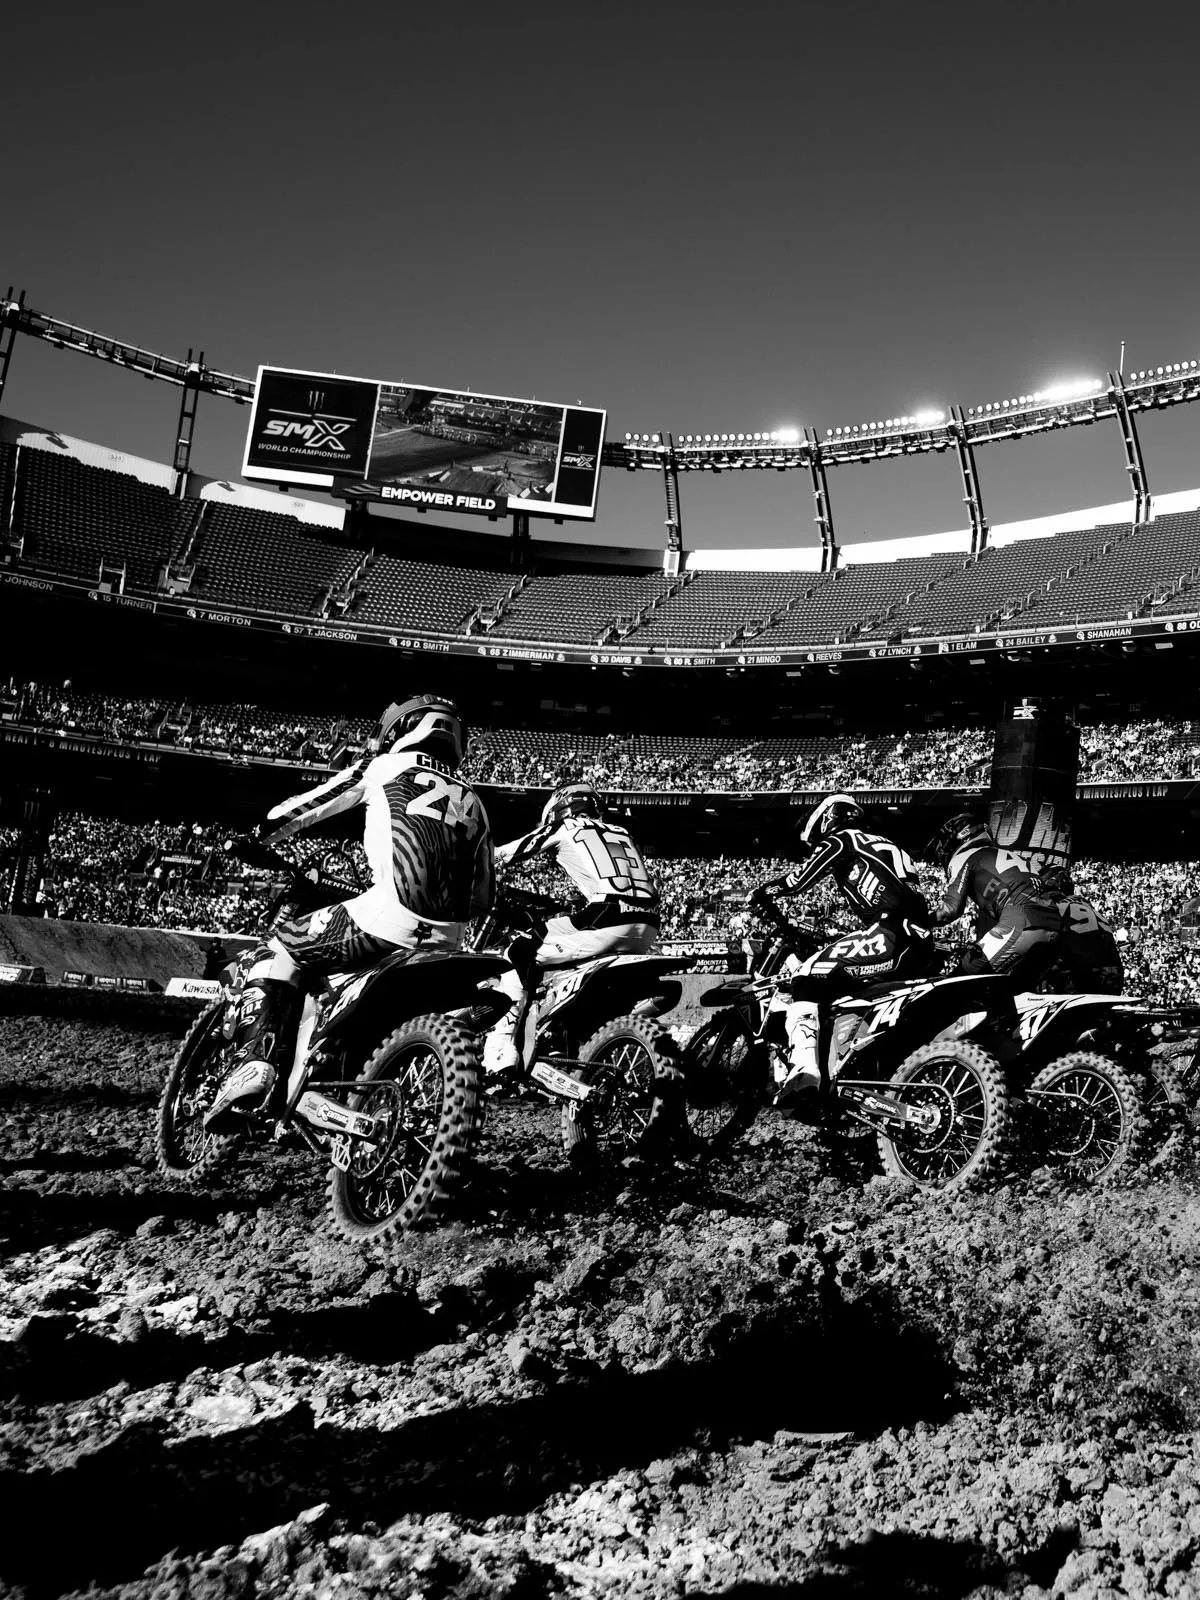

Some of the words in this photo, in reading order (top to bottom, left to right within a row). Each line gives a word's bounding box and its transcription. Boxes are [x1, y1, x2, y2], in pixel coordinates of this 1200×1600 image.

[262, 418, 351, 451] SMX
[257, 443, 289, 454] WORLD
[289, 446, 352, 460] CHAMPIONSHIP
[562, 454, 596, 469] SMX
[381, 486, 454, 509] EMPOWER
[456, 495, 496, 511] FIELD
[6, 577, 54, 592] JOHNSON
[102, 594, 112, 602] 15
[116, 597, 153, 610] TURNER
[208, 613, 252, 626] MORTON
[1176, 622, 1187, 631] 88
[293, 627, 304, 635] 57
[315, 630, 358, 641] JACKSON
[1087, 628, 1132, 639] SHANAHAN
[400, 640, 411, 648] 49
[423, 642, 450, 652] SMITH
[956, 642, 978, 650] ELAM
[1005, 639, 1015, 647] 24
[1016, 636, 1046, 646] BAILEY
[502, 650, 555, 661] ZIMMERMAN
[816, 652, 843, 661] REEVES
[878, 648, 887, 656] 47
[888, 647, 912, 656] LYNCH
[600, 655, 610, 663] 30
[611, 656, 632, 664] DAVIS
[747, 656, 755, 664] 21
[756, 656, 781, 664] MINGO
[405, 772, 479, 840] 24
[829, 933, 887, 958] FXR
[859, 959, 894, 971] TRIUMPH
[182, 982, 221, 995] Kawasak
[867, 996, 907, 1034] 74
